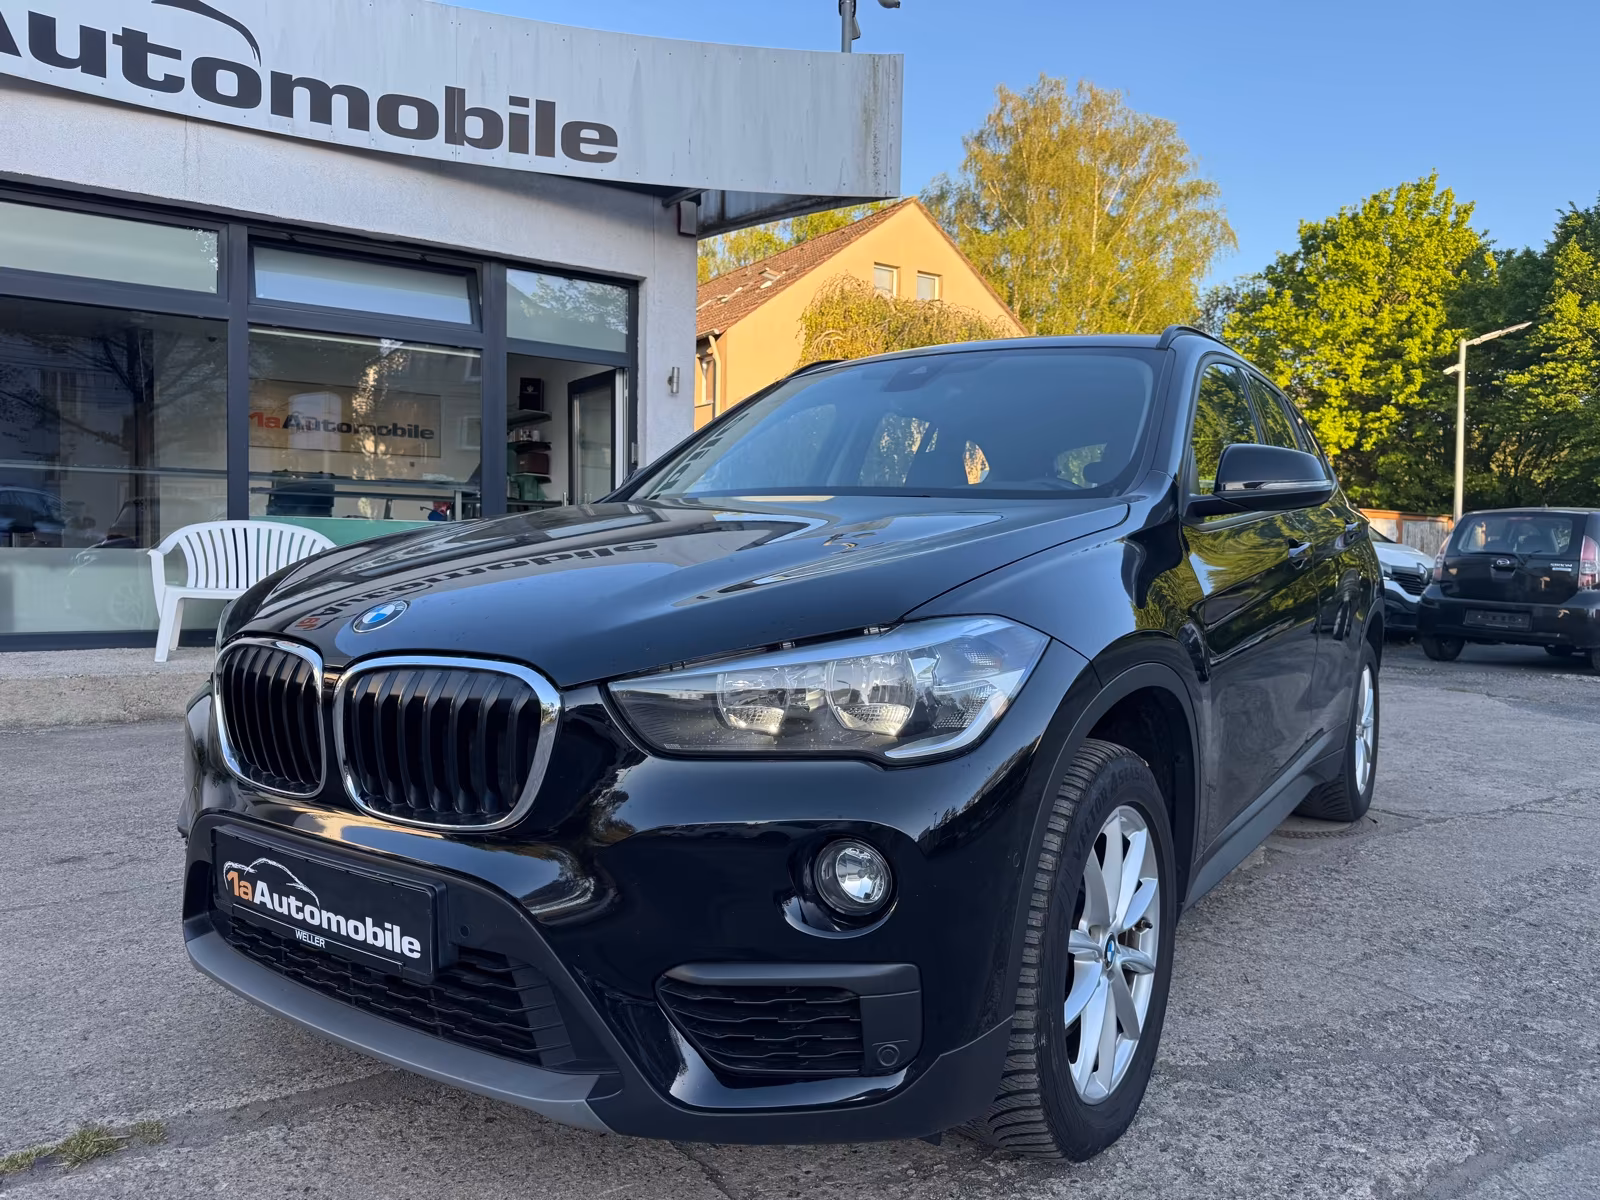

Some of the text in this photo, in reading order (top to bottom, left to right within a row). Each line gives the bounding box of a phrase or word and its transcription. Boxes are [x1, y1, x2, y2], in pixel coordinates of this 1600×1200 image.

[0, 10, 618, 164] utomobile
[226, 871, 421, 959] 1aAutomobile
[295, 929, 325, 949] WELLER
